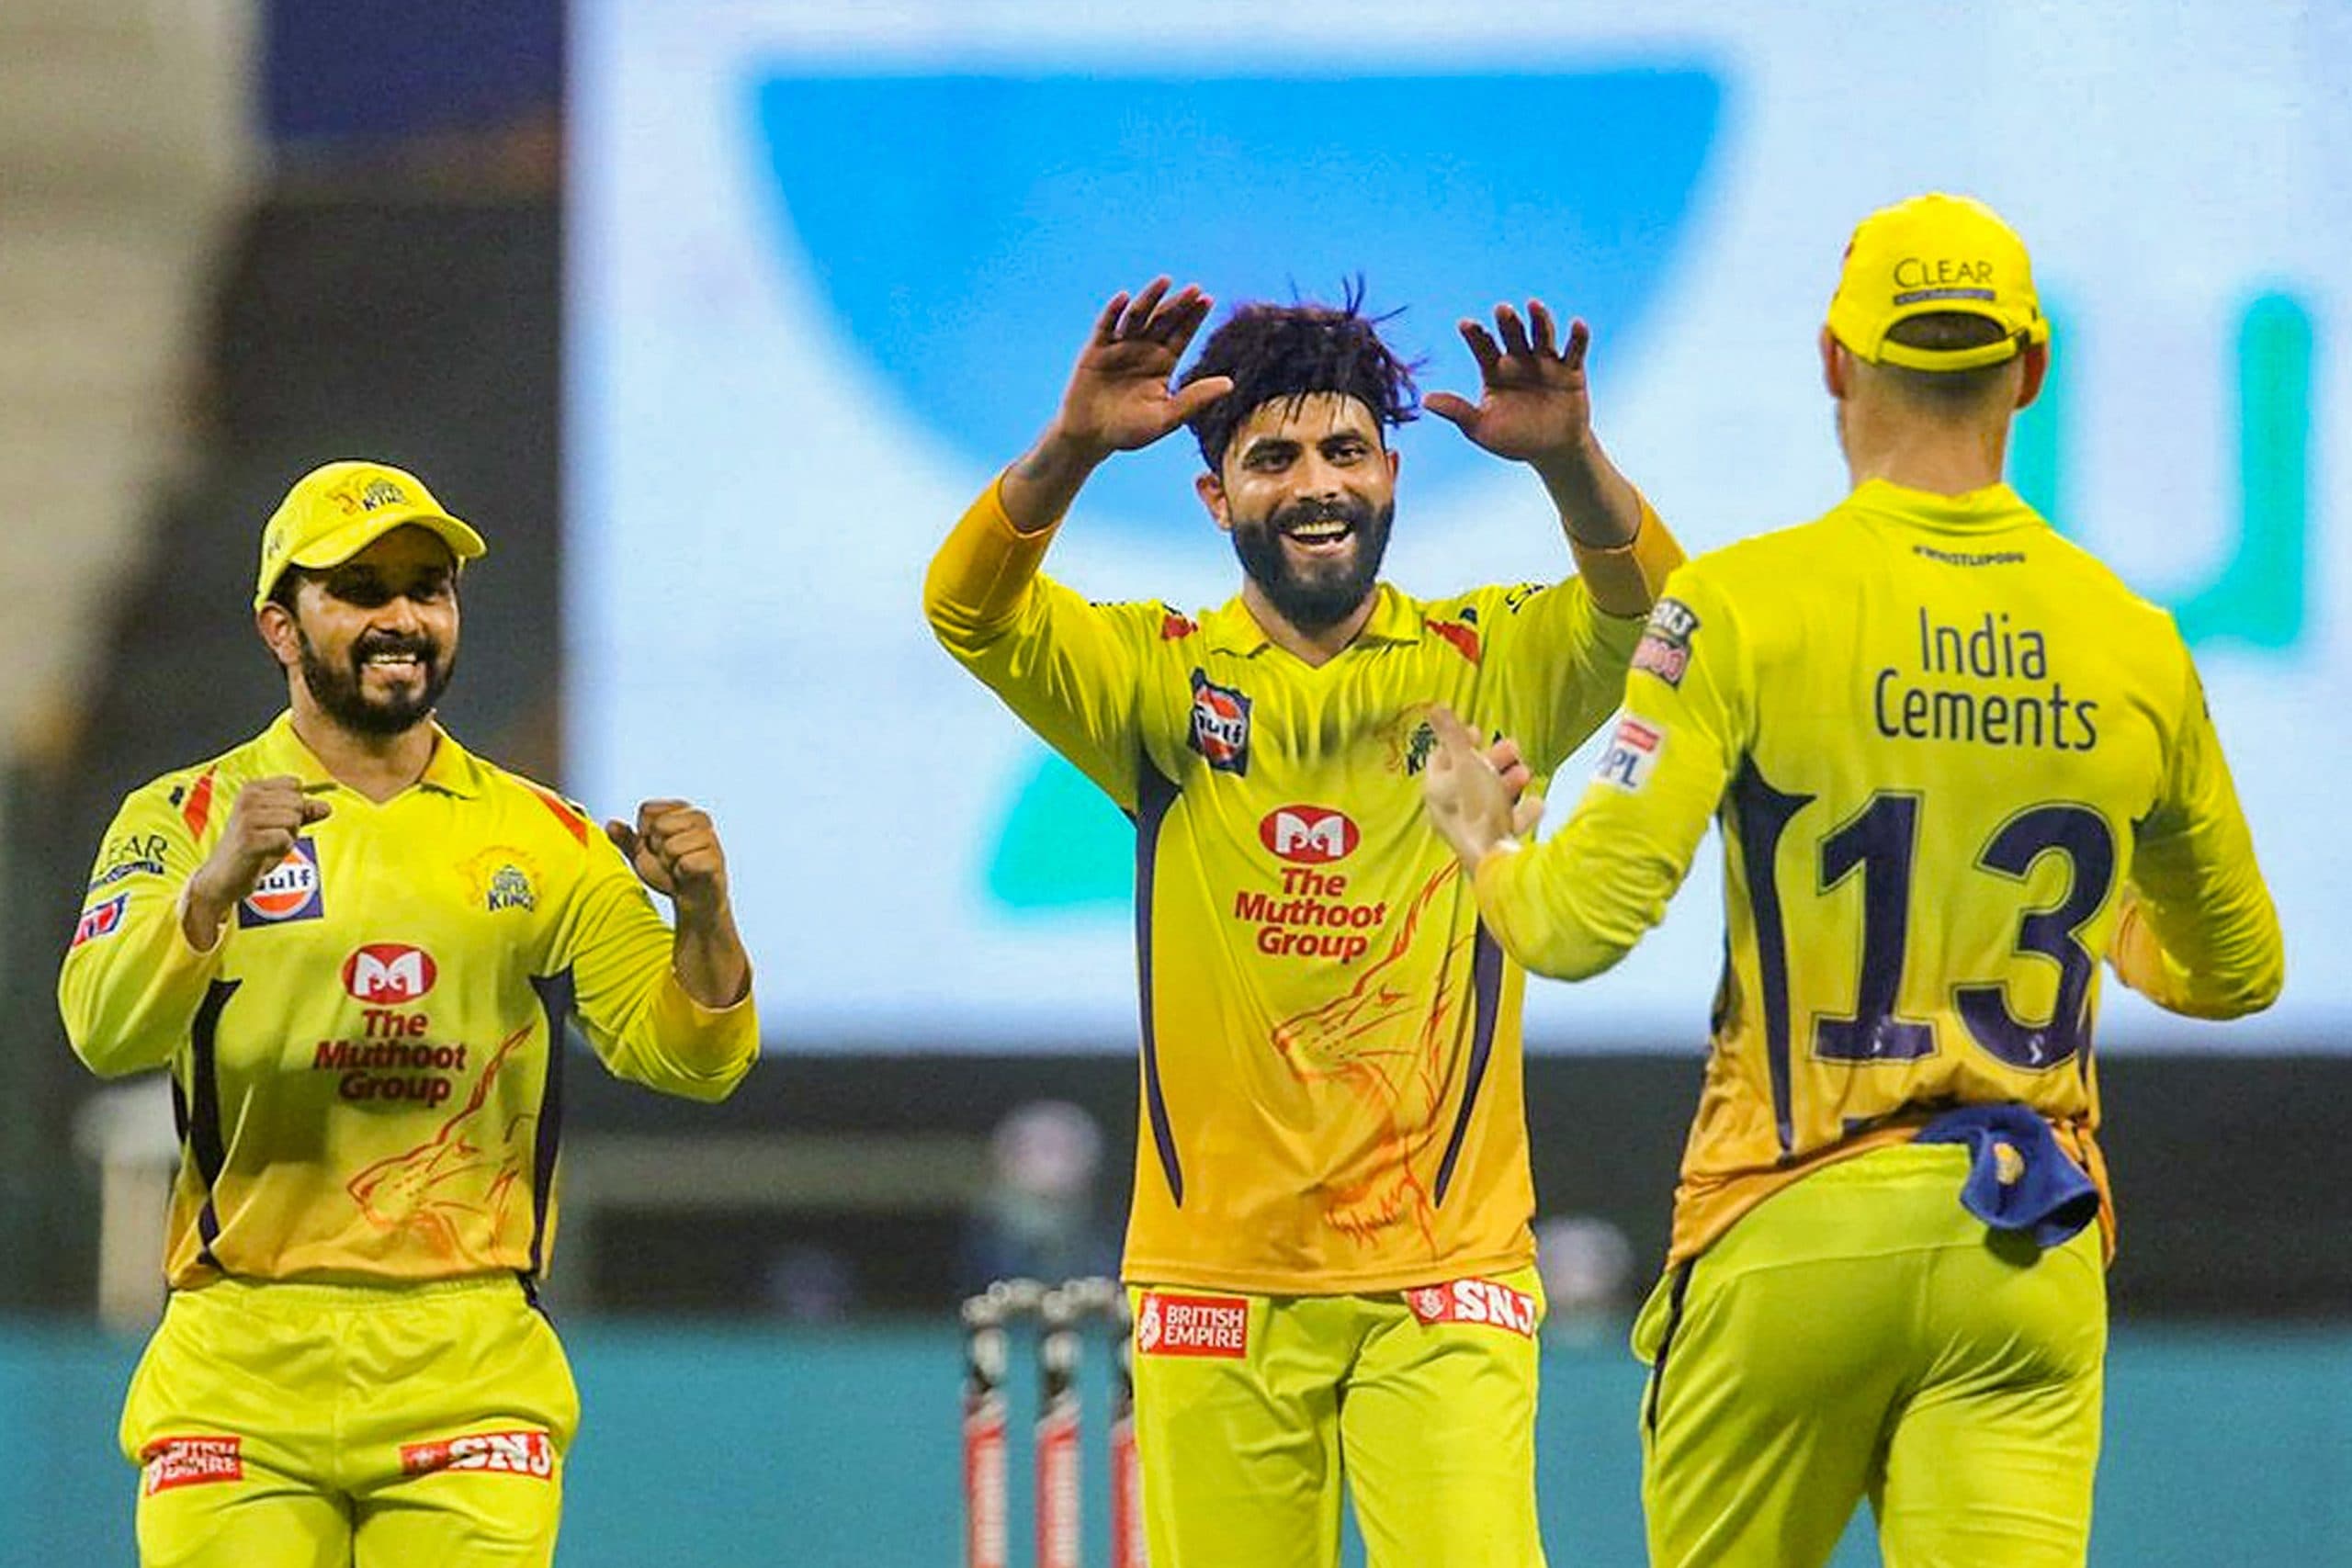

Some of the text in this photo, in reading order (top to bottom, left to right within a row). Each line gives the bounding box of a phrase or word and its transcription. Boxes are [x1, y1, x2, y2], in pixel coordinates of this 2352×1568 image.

[1894, 257, 1993, 288] CLEAR
[1919, 606, 2046, 681] India
[1874, 668, 2098, 751] Cements
[1280, 867, 1347, 897] The
[1234, 891, 1385, 929] Muthoot
[1807, 787, 2120, 1068] 13
[1257, 925, 1368, 964] Group
[361, 1009, 428, 1038] The
[313, 1039, 466, 1072] Muthoot
[338, 1069, 452, 1108] Group
[1165, 1304, 1244, 1329] BRITISH
[1453, 1278, 1535, 1336] SNJ
[1163, 1325, 1243, 1348] EMPIRE
[447, 1433, 550, 1475] SNJ
